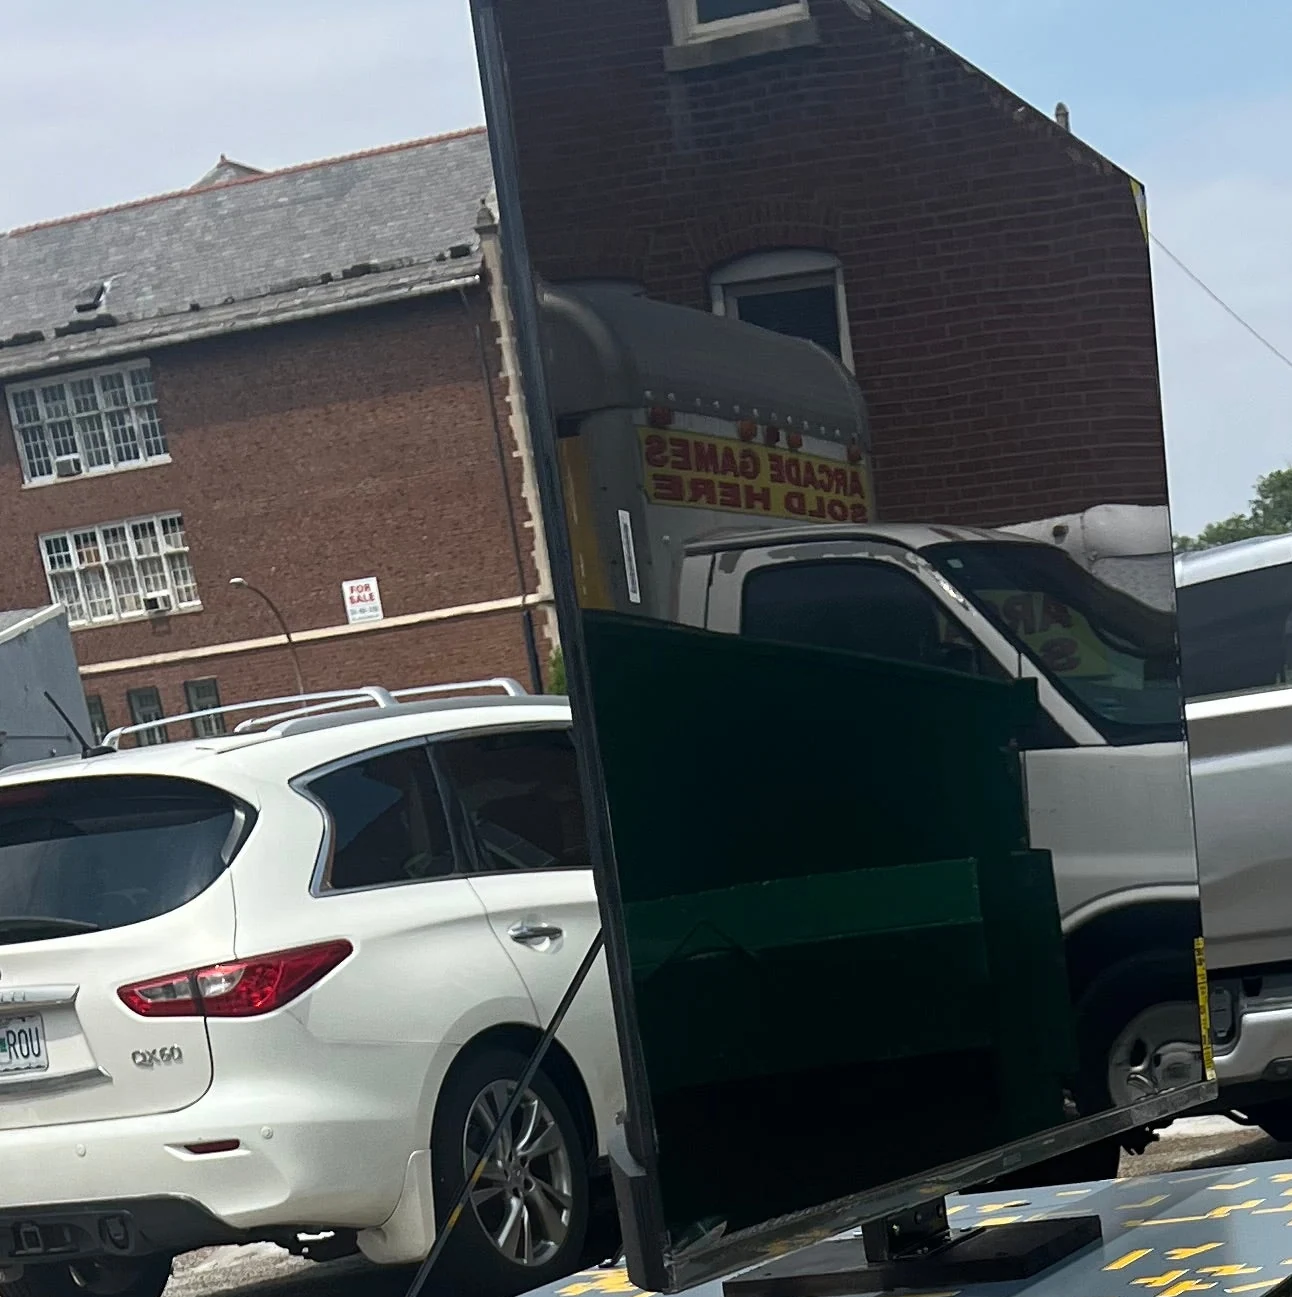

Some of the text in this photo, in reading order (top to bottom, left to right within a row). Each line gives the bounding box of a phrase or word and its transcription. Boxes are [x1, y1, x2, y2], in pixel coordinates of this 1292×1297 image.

[350, 583, 371, 594] FOR
[349, 592, 376, 604] SALE
[131, 1045, 183, 1068] QX60
